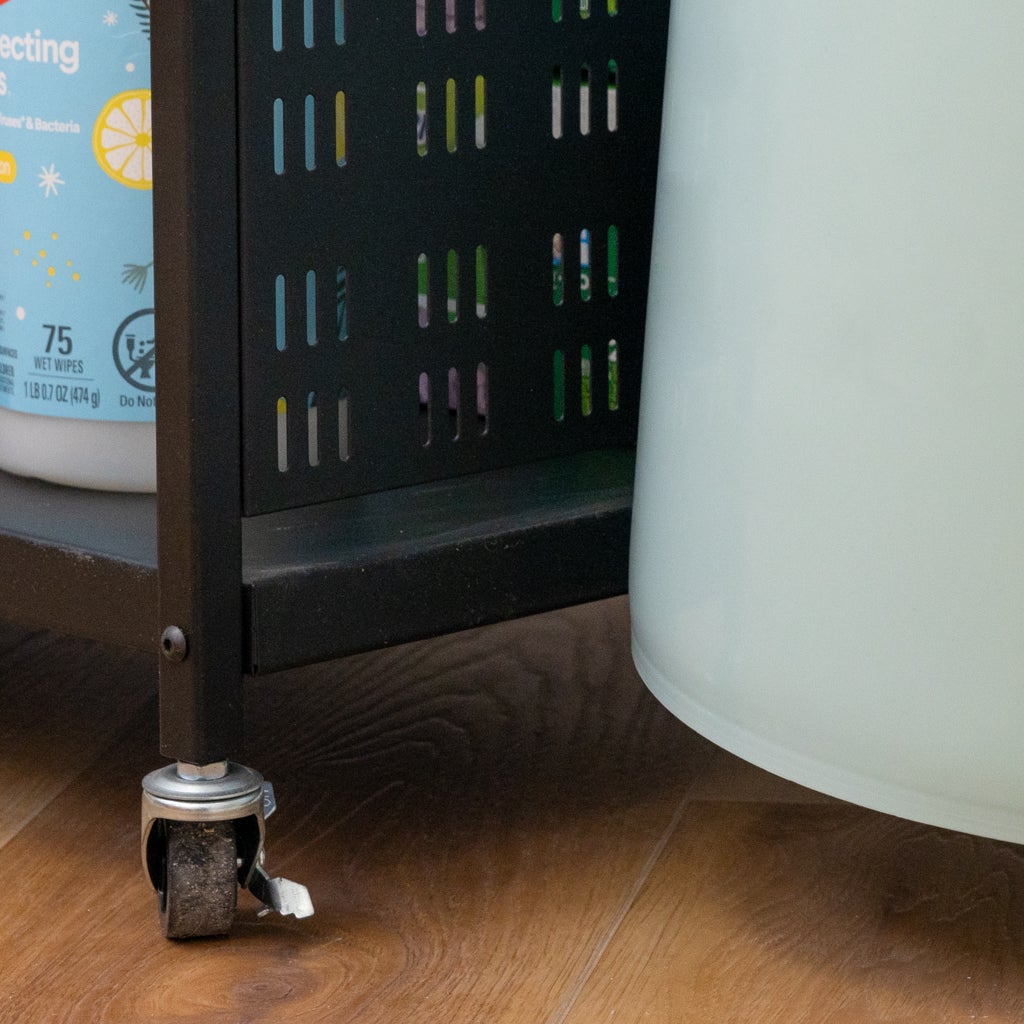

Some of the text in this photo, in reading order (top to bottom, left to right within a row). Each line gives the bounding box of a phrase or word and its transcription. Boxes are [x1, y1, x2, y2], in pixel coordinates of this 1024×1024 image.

[0, 29, 80, 74] ecting
[26, 116, 34, 131] &
[35, 117, 81, 134] Bacteria
[42, 324, 73, 355] 75
[34, 356, 52, 372] WET
[54, 358, 84, 374] WIPES
[29, 382, 40, 399] LB
[55, 384, 69, 403] OZ
[120, 394, 135, 407] Do
